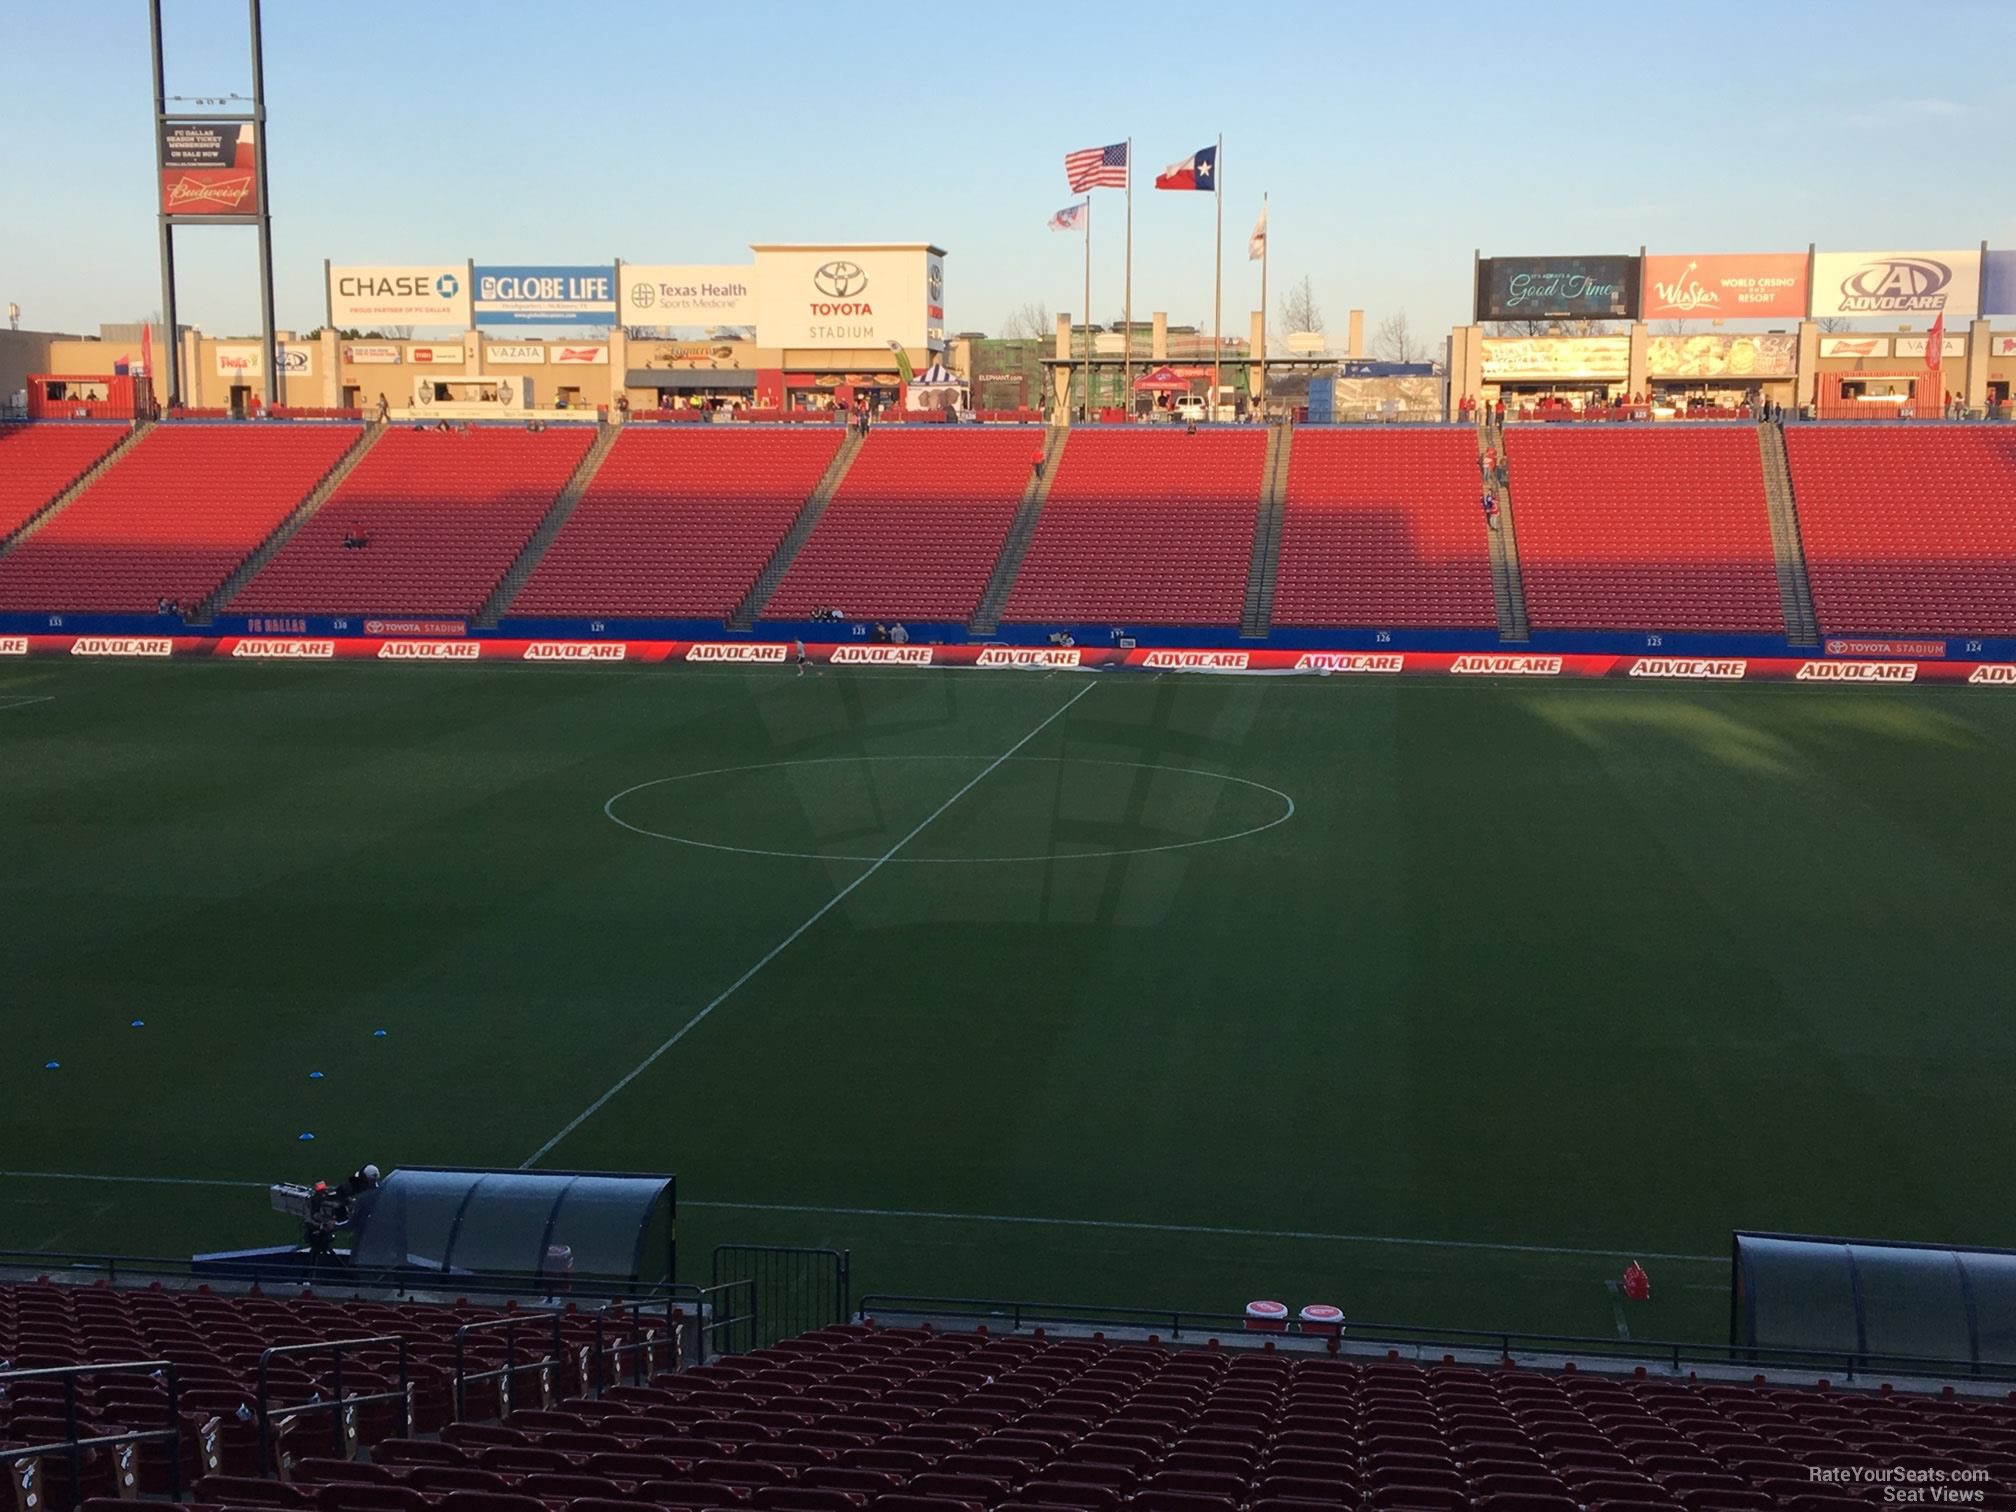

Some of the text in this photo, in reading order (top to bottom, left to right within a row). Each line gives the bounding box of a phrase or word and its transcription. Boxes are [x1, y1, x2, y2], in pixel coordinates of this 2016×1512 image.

[166, 184, 249, 198] Budweiser
[339, 277, 431, 297] CHASE
[496, 277, 609, 300] GLOBE LIFE
[1653, 266, 1720, 310] WinStar
[1720, 277, 1795, 287] WORLD CASINO
[658, 283, 747, 297] Texas Health
[1507, 273, 1613, 307] Good Time
[659, 298, 736, 309] Sports Medicine
[1738, 293, 1775, 303] RESORT
[1839, 294, 1946, 311] ADVOCARE
[809, 303, 873, 316] TOYOTA
[809, 326, 875, 339] STADIUM
[491, 347, 540, 358] VAZATA
[1907, 341, 1953, 350] VAA
[248, 619, 306, 633] FC DALLAS
[385, 624, 465, 633] TOYOTA STADIUM
[1376, 633, 1391, 643] 126
[1647, 638, 1662, 647] 125
[0, 639, 26, 652] RE
[73, 640, 170, 654] ADVOCARE
[234, 641, 332, 655] ADVOCARE
[380, 643, 477, 657] ADVOCARE
[525, 644, 623, 658] ADVOCARE
[1850, 644, 1944, 654] TOYOTA STADIUM
[1966, 643, 1981, 652] 124
[688, 646, 785, 660] ADVOCARE
[832, 648, 930, 662] ADVOCARE
[978, 651, 1078, 664] ADVOCARE
[1145, 653, 1247, 667] ADVOCARE
[1297, 656, 1401, 670] ADVOCARE
[1452, 658, 1560, 672] ADVOCARE
[1631, 661, 1744, 676] ADVOCARE
[1799, 664, 1915, 679] ADVOCARE
